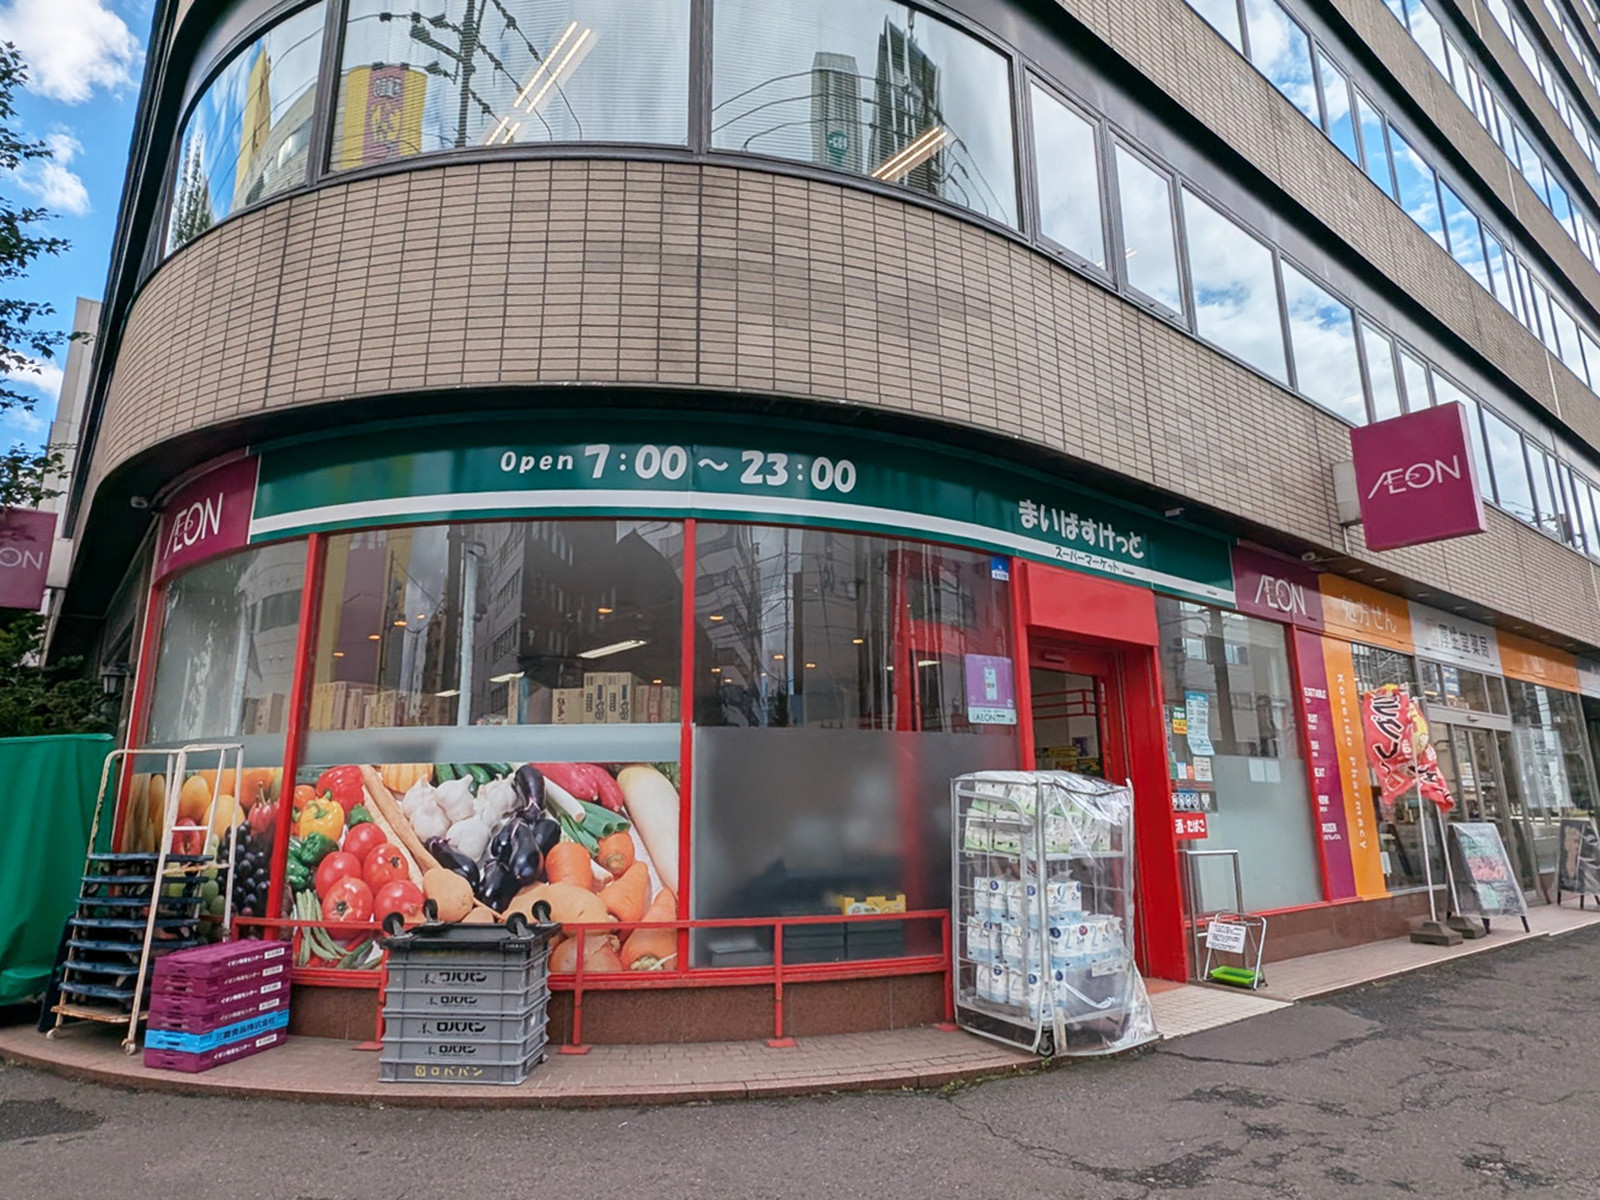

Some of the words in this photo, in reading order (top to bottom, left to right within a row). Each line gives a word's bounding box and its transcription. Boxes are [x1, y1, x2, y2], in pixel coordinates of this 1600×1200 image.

[500, 450, 573, 474] Open
[584, 444, 688, 480] 7:00
[740, 450, 857, 493] 23:00
[1368, 455, 1461, 499] AEON
[164, 492, 223, 560] AEON
[1019, 500, 1144, 559] まいばすけっと
[0, 547, 44, 570] ON
[1055, 546, 1119, 572] スーパーマーケット
[1255, 574, 1306, 616] AEON
